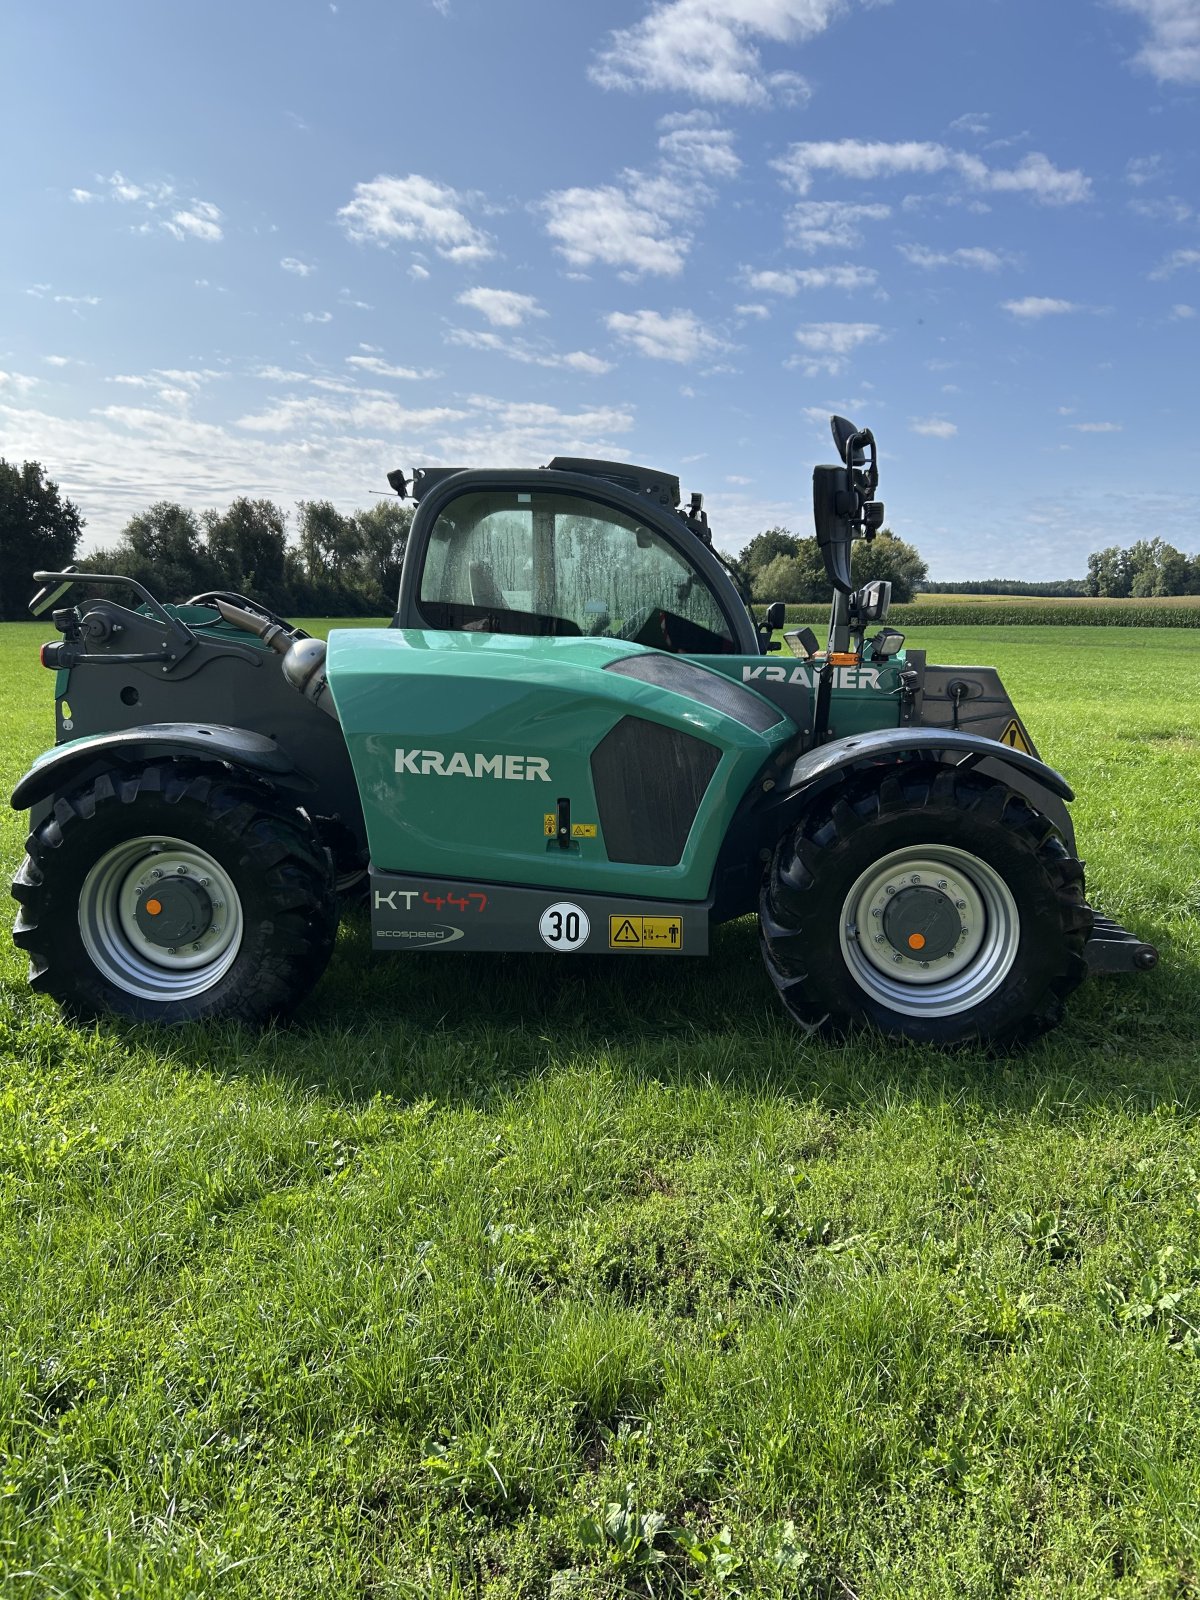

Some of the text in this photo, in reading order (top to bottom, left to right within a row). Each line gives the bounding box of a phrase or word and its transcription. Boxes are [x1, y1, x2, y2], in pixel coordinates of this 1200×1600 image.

[394, 748, 552, 782] KRAMER
[374, 890, 487, 912] KT 447
[376, 930, 445, 939] ecospeed
[548, 911, 580, 942] 30
